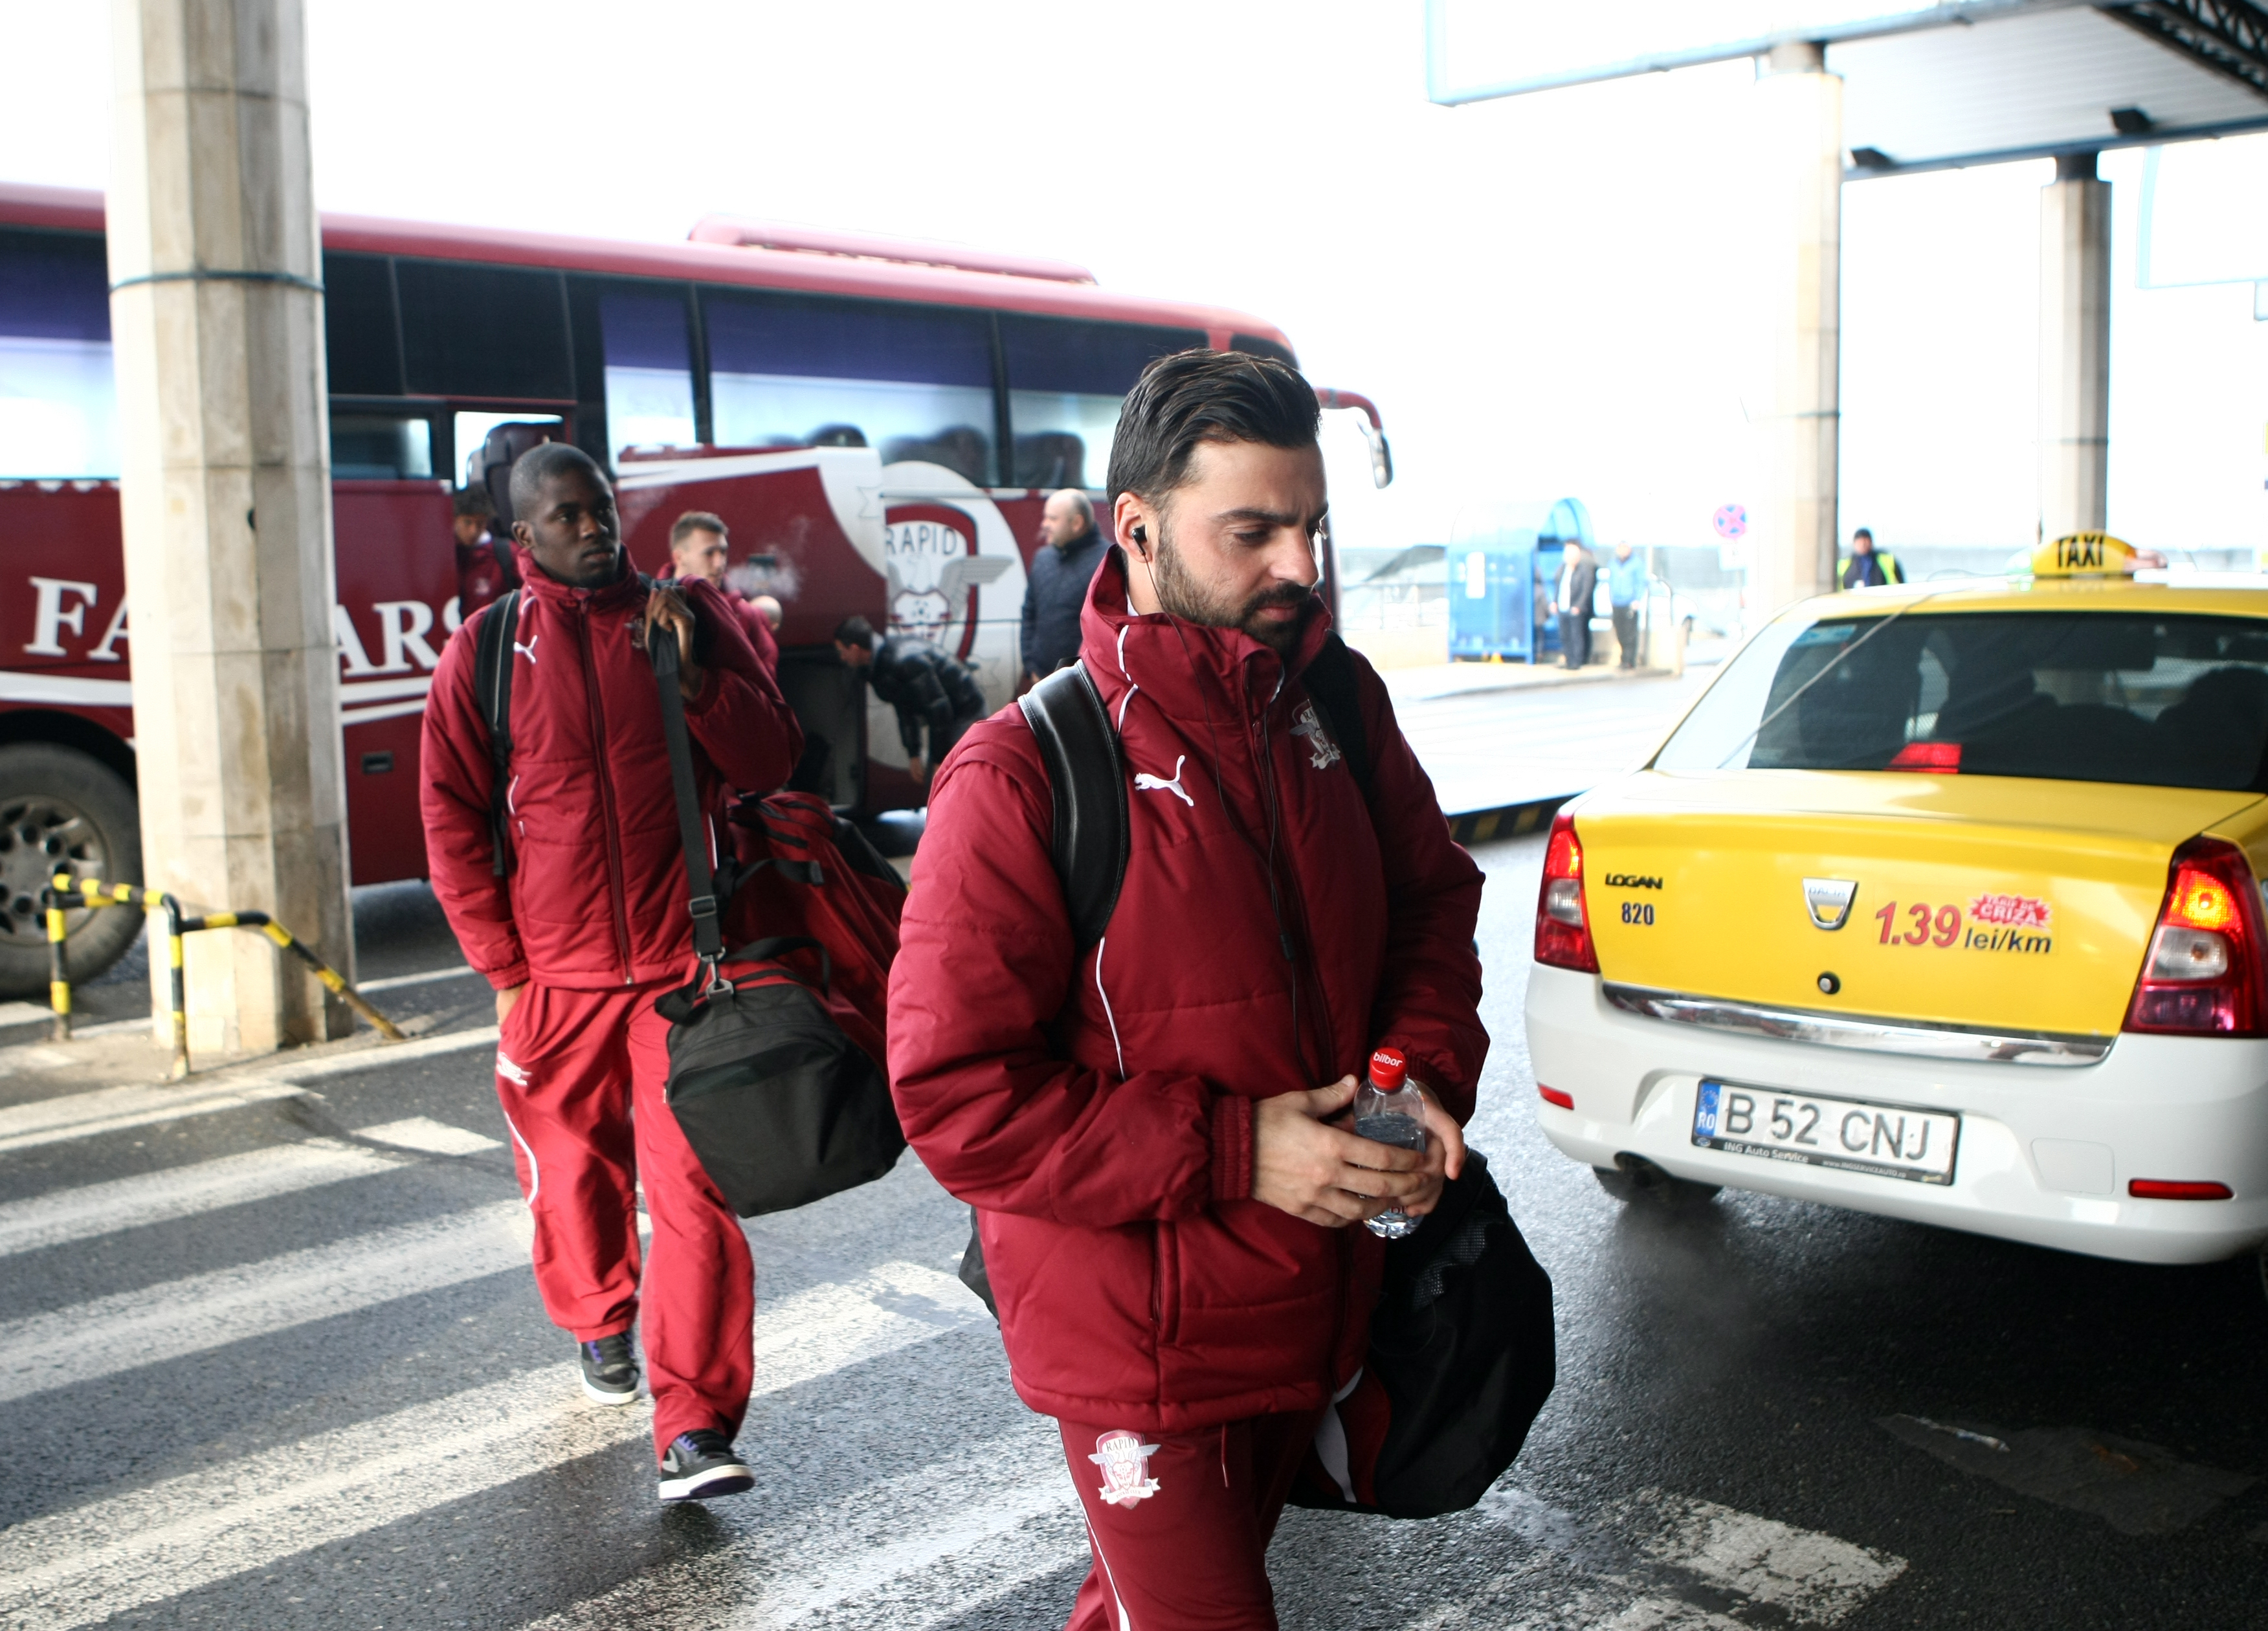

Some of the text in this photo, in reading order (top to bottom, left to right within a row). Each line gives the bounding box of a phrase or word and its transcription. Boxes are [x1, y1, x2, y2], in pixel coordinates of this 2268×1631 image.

[885, 524, 957, 555] RAPID
[2056, 534, 2104, 568] TAXI
[1605, 872, 1663, 890] LOGAN
[1621, 901, 1654, 925] 820
[1876, 901, 1962, 947] 1.39
[1964, 927, 2052, 953] lei/km
[1373, 1052, 1403, 1067] bilbor
[1697, 1111, 1715, 1130] RO
[1726, 1093, 1931, 1160] B 52 CNJ
[1724, 1141, 1809, 1163] ING Auto Service
[1106, 1437, 1135, 1452] RAPID
